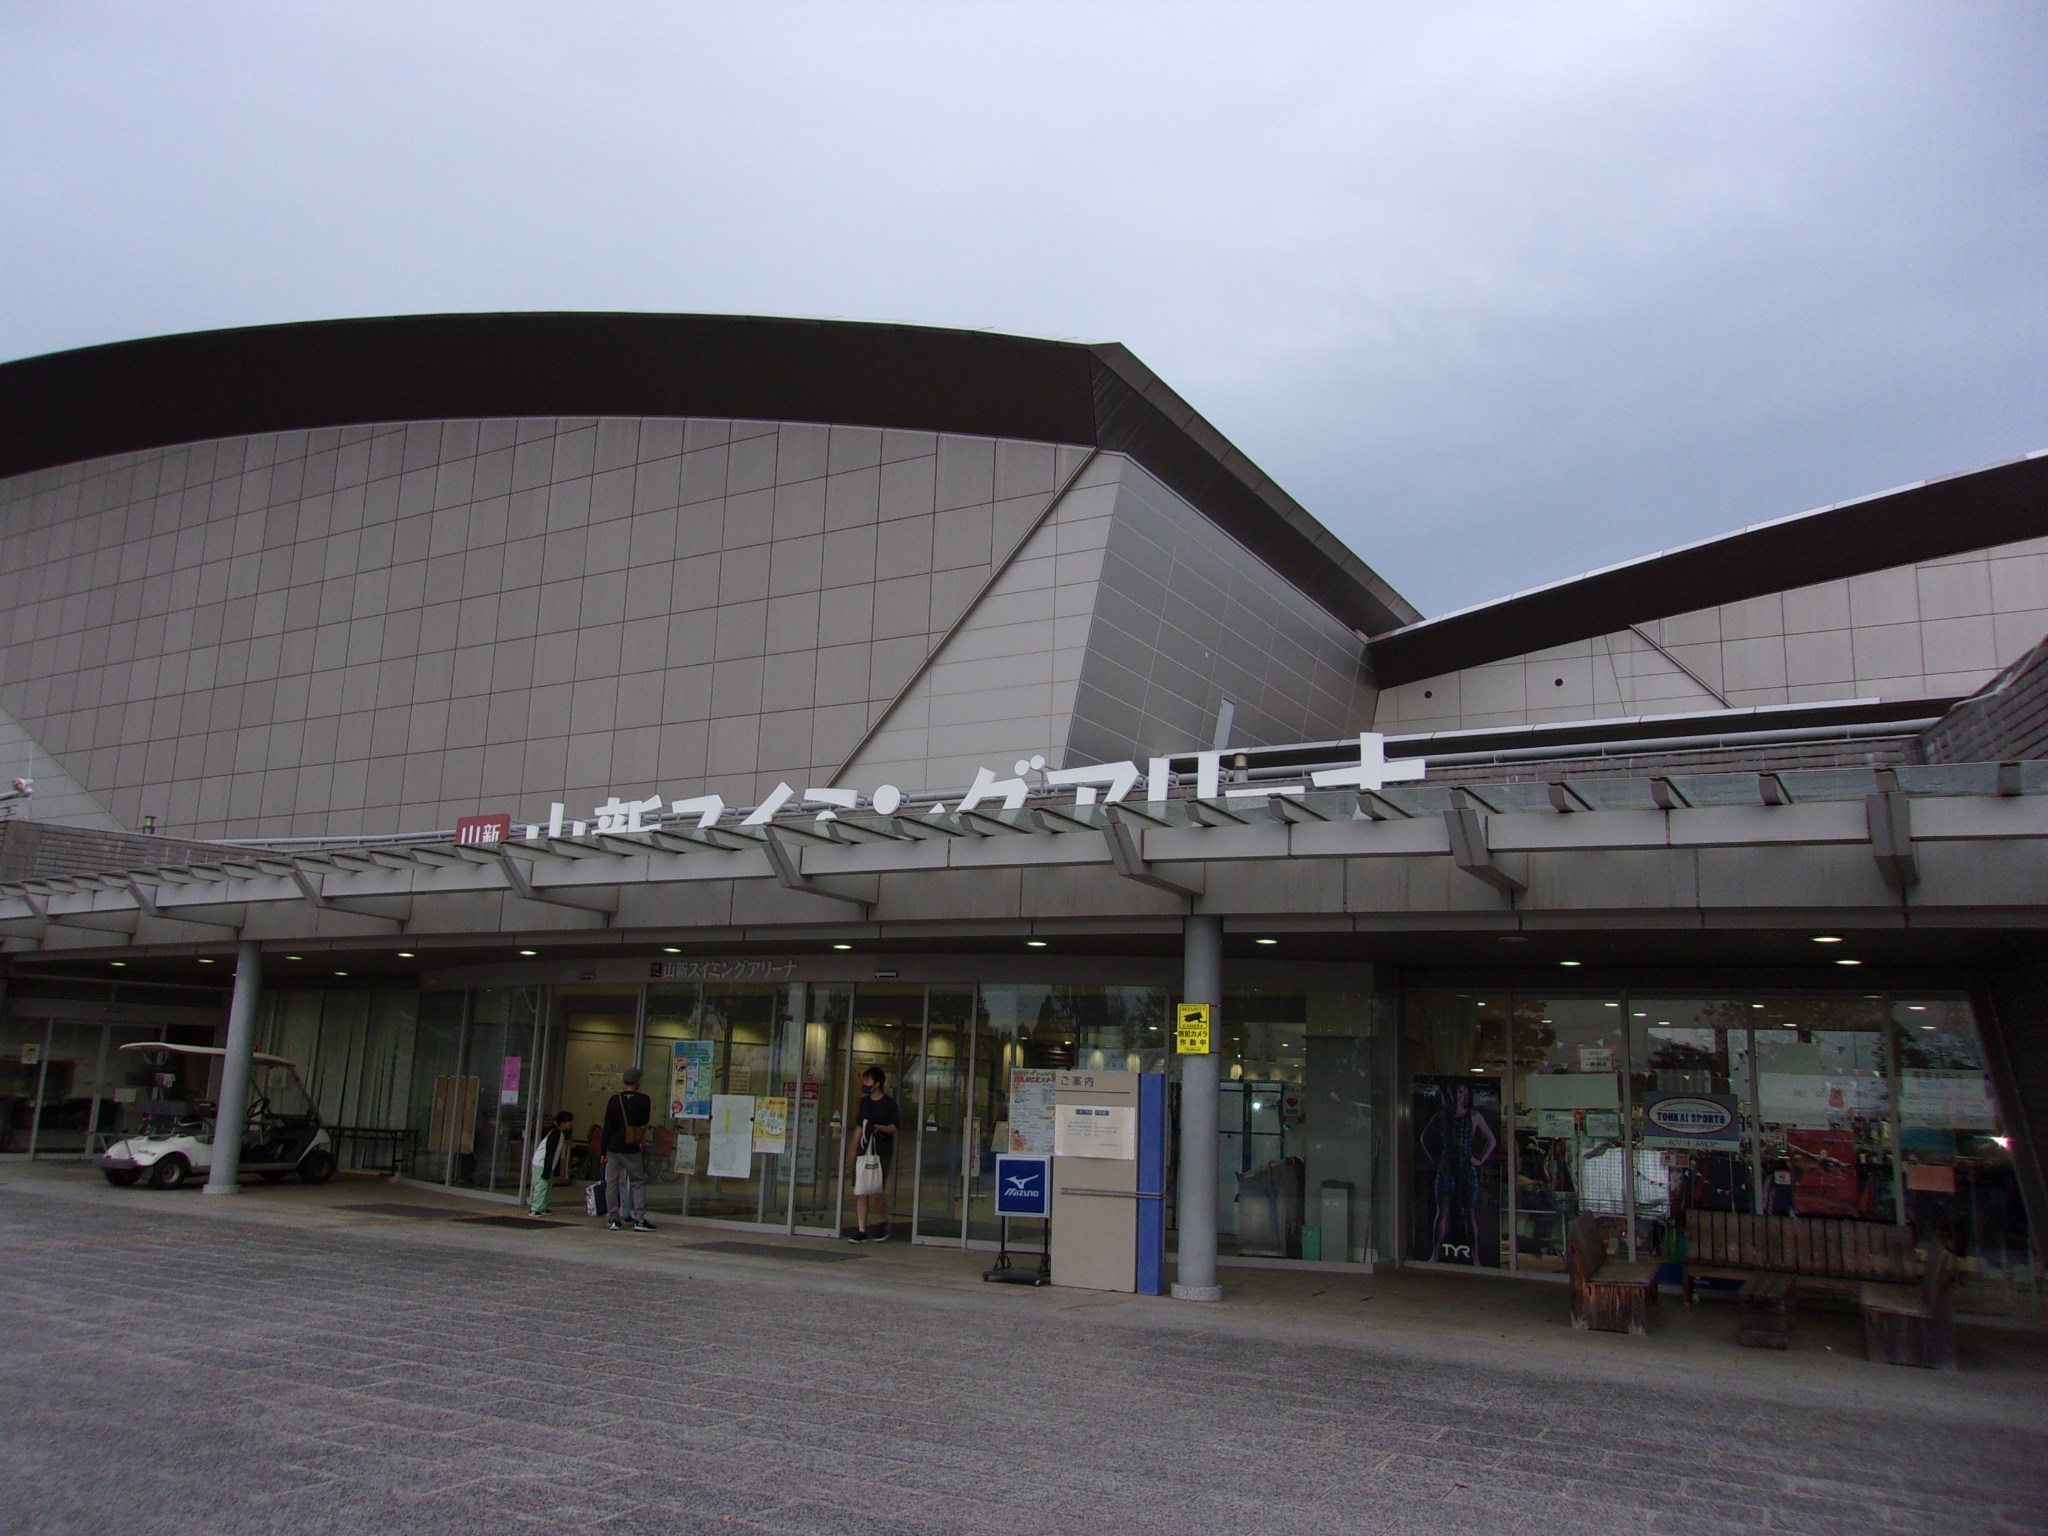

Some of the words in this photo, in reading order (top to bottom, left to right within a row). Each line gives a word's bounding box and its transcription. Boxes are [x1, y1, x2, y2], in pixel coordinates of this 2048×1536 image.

[663, 959, 798, 979] 山新スイミングアリーナ
[1178, 1030, 1208, 1038] 防犯カメラ
[1179, 1038, 1207, 1047] 作動中
[1060, 1075, 1095, 1088] ご案内
[1656, 1112, 1689, 1123] TOHKAI
[1691, 1113, 1726, 1125] SPORTS
[1695, 1140, 1719, 1149] SHOP
[1441, 1243, 1471, 1259] TYR
